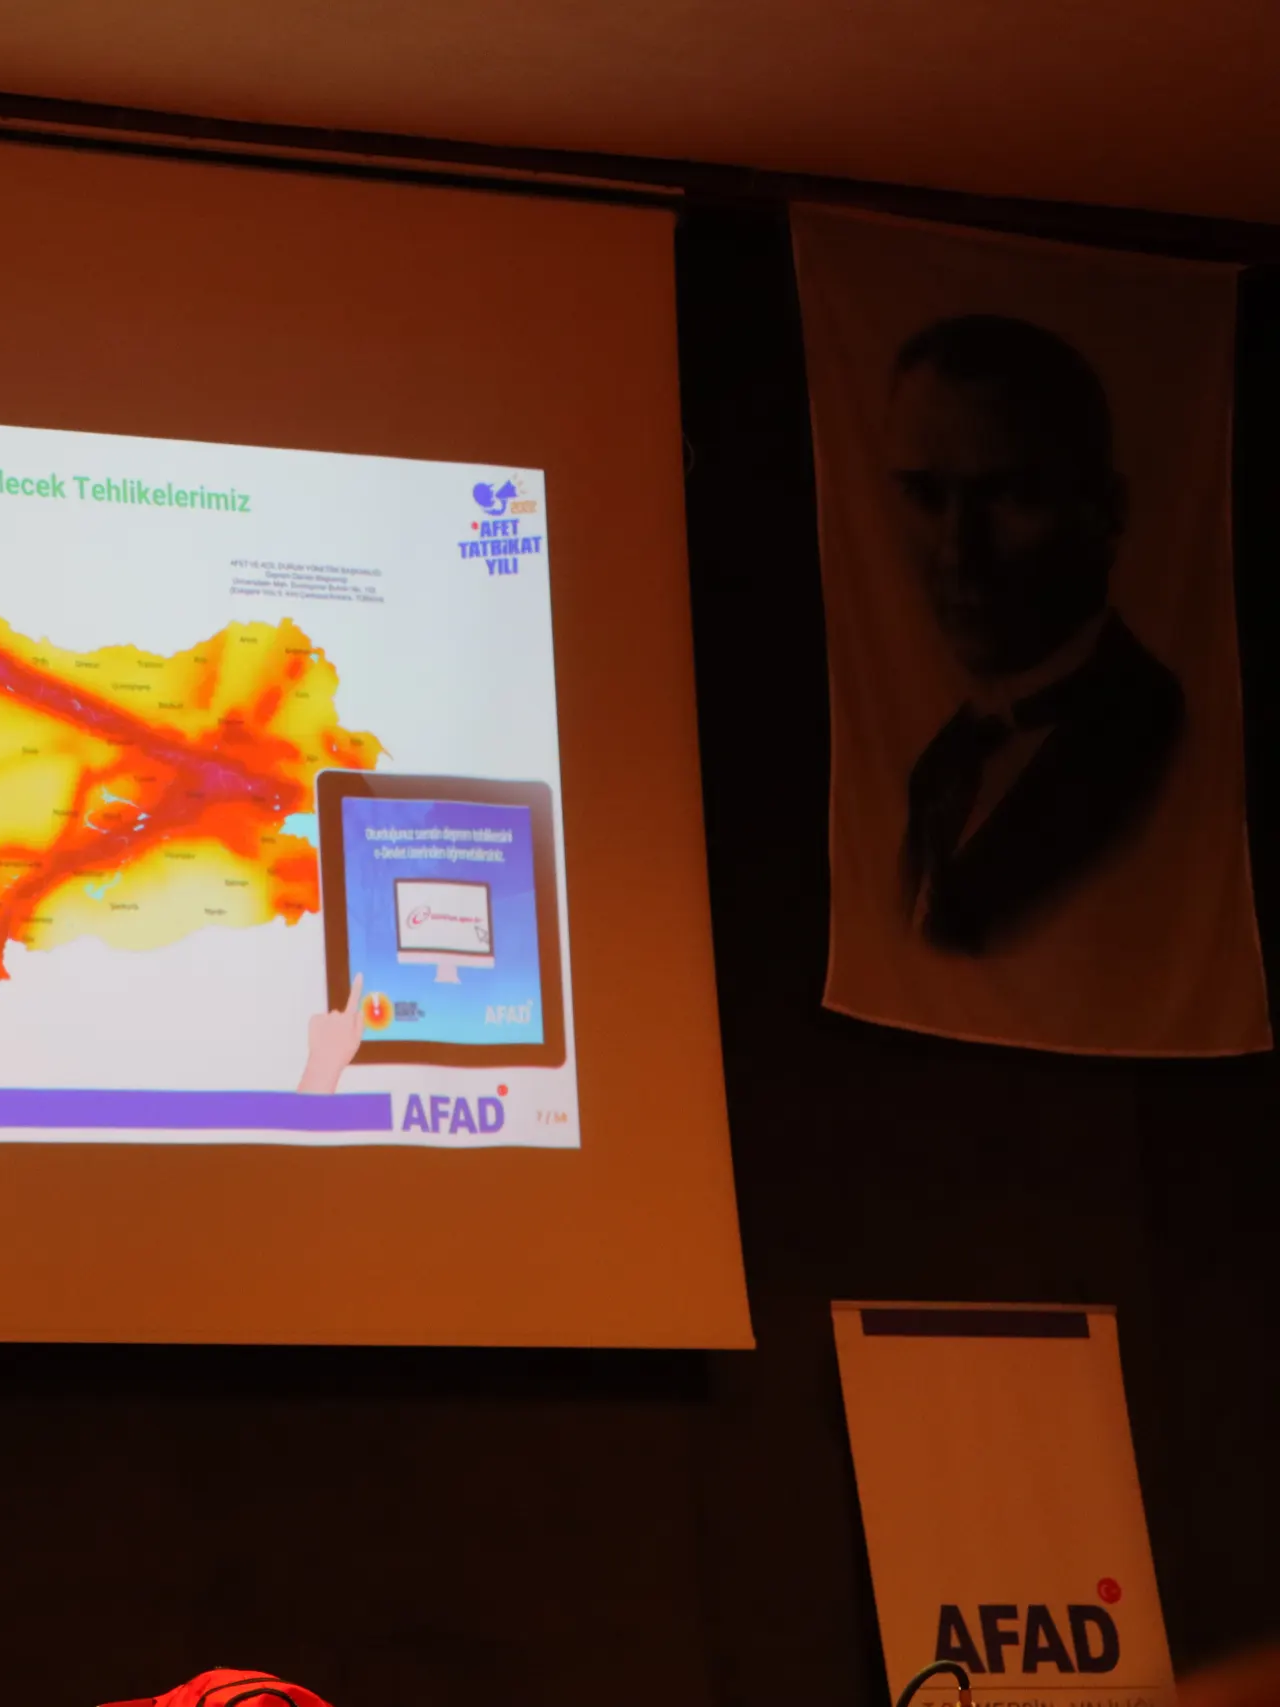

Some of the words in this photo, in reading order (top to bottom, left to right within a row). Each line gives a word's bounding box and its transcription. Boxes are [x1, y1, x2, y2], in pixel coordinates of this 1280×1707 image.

[73, 475, 252, 514] Tehlikelerimiz
[480, 519, 519, 537] AFET
[485, 557, 519, 576] YILI
[485, 1004, 531, 1025] AFAD
[402, 1093, 505, 1134] AFAD
[935, 1604, 1120, 1674] AFAD
